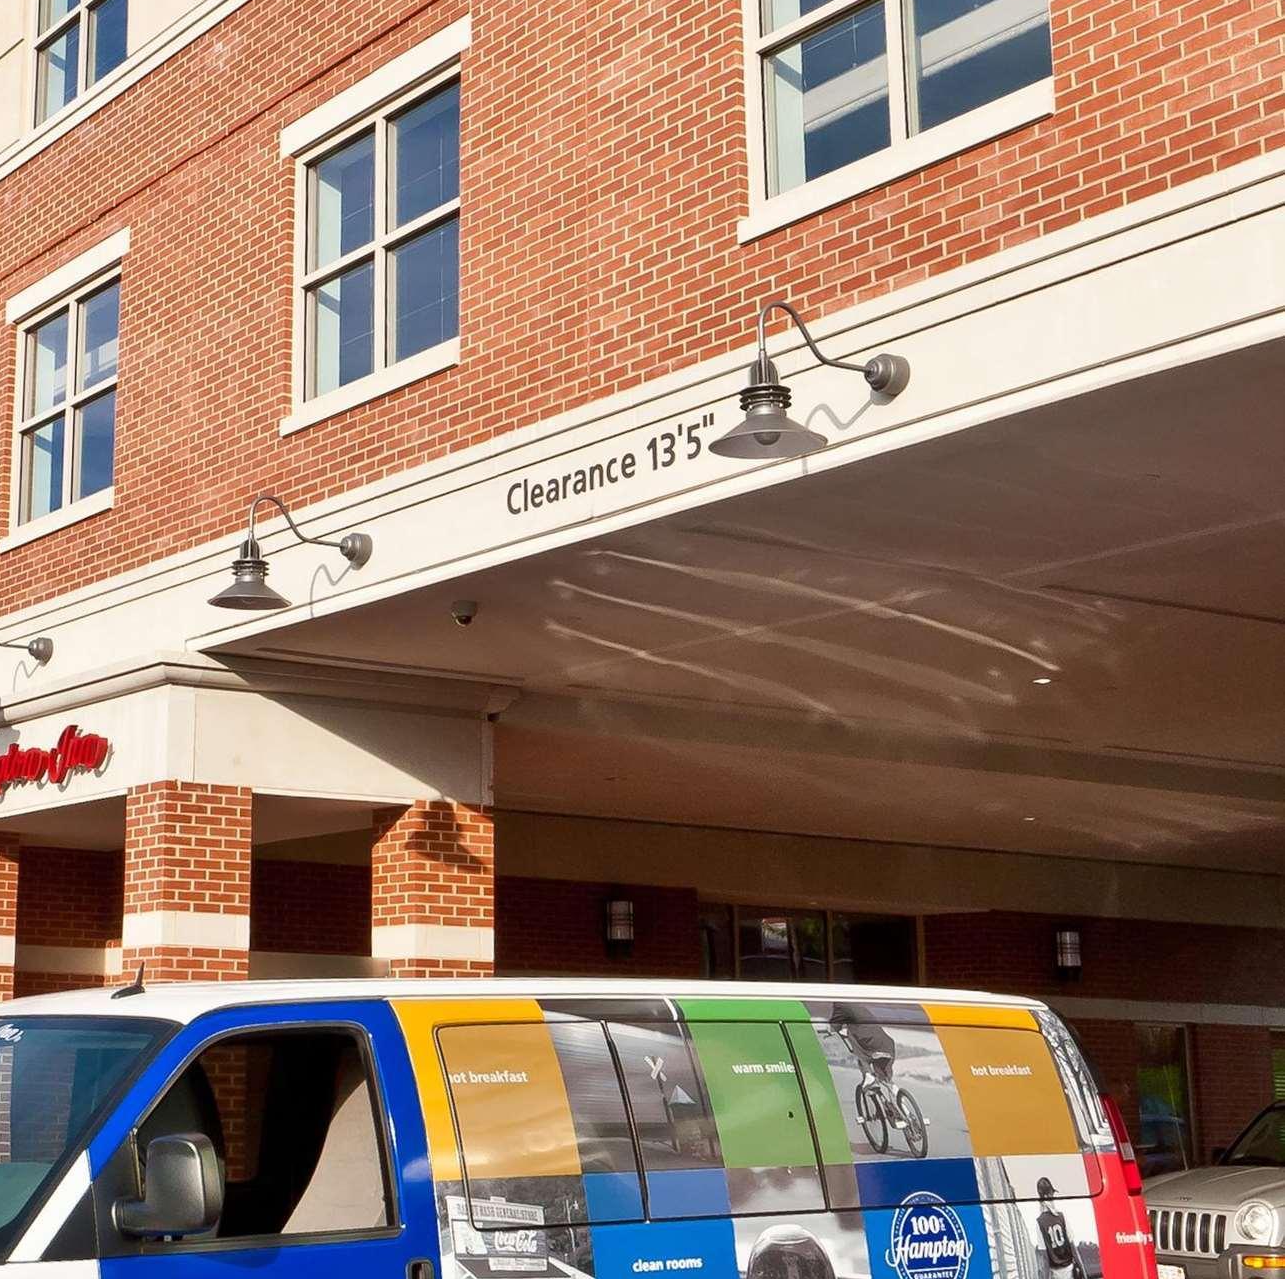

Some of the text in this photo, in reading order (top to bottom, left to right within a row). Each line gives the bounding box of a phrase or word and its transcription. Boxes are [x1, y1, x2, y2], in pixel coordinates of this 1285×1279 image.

[506, 412, 715, 515] Clearance 13'5"
[731, 1064, 764, 1074] warm
[970, 1064, 1033, 1076] hot breakfast
[468, 1070, 529, 1084] breakfast
[1047, 1223, 1065, 1249] 10
[1115, 1230, 1148, 1245] friendly
[885, 1233, 973, 1268] Hampton
[632, 1257, 703, 1272] clean rooms
